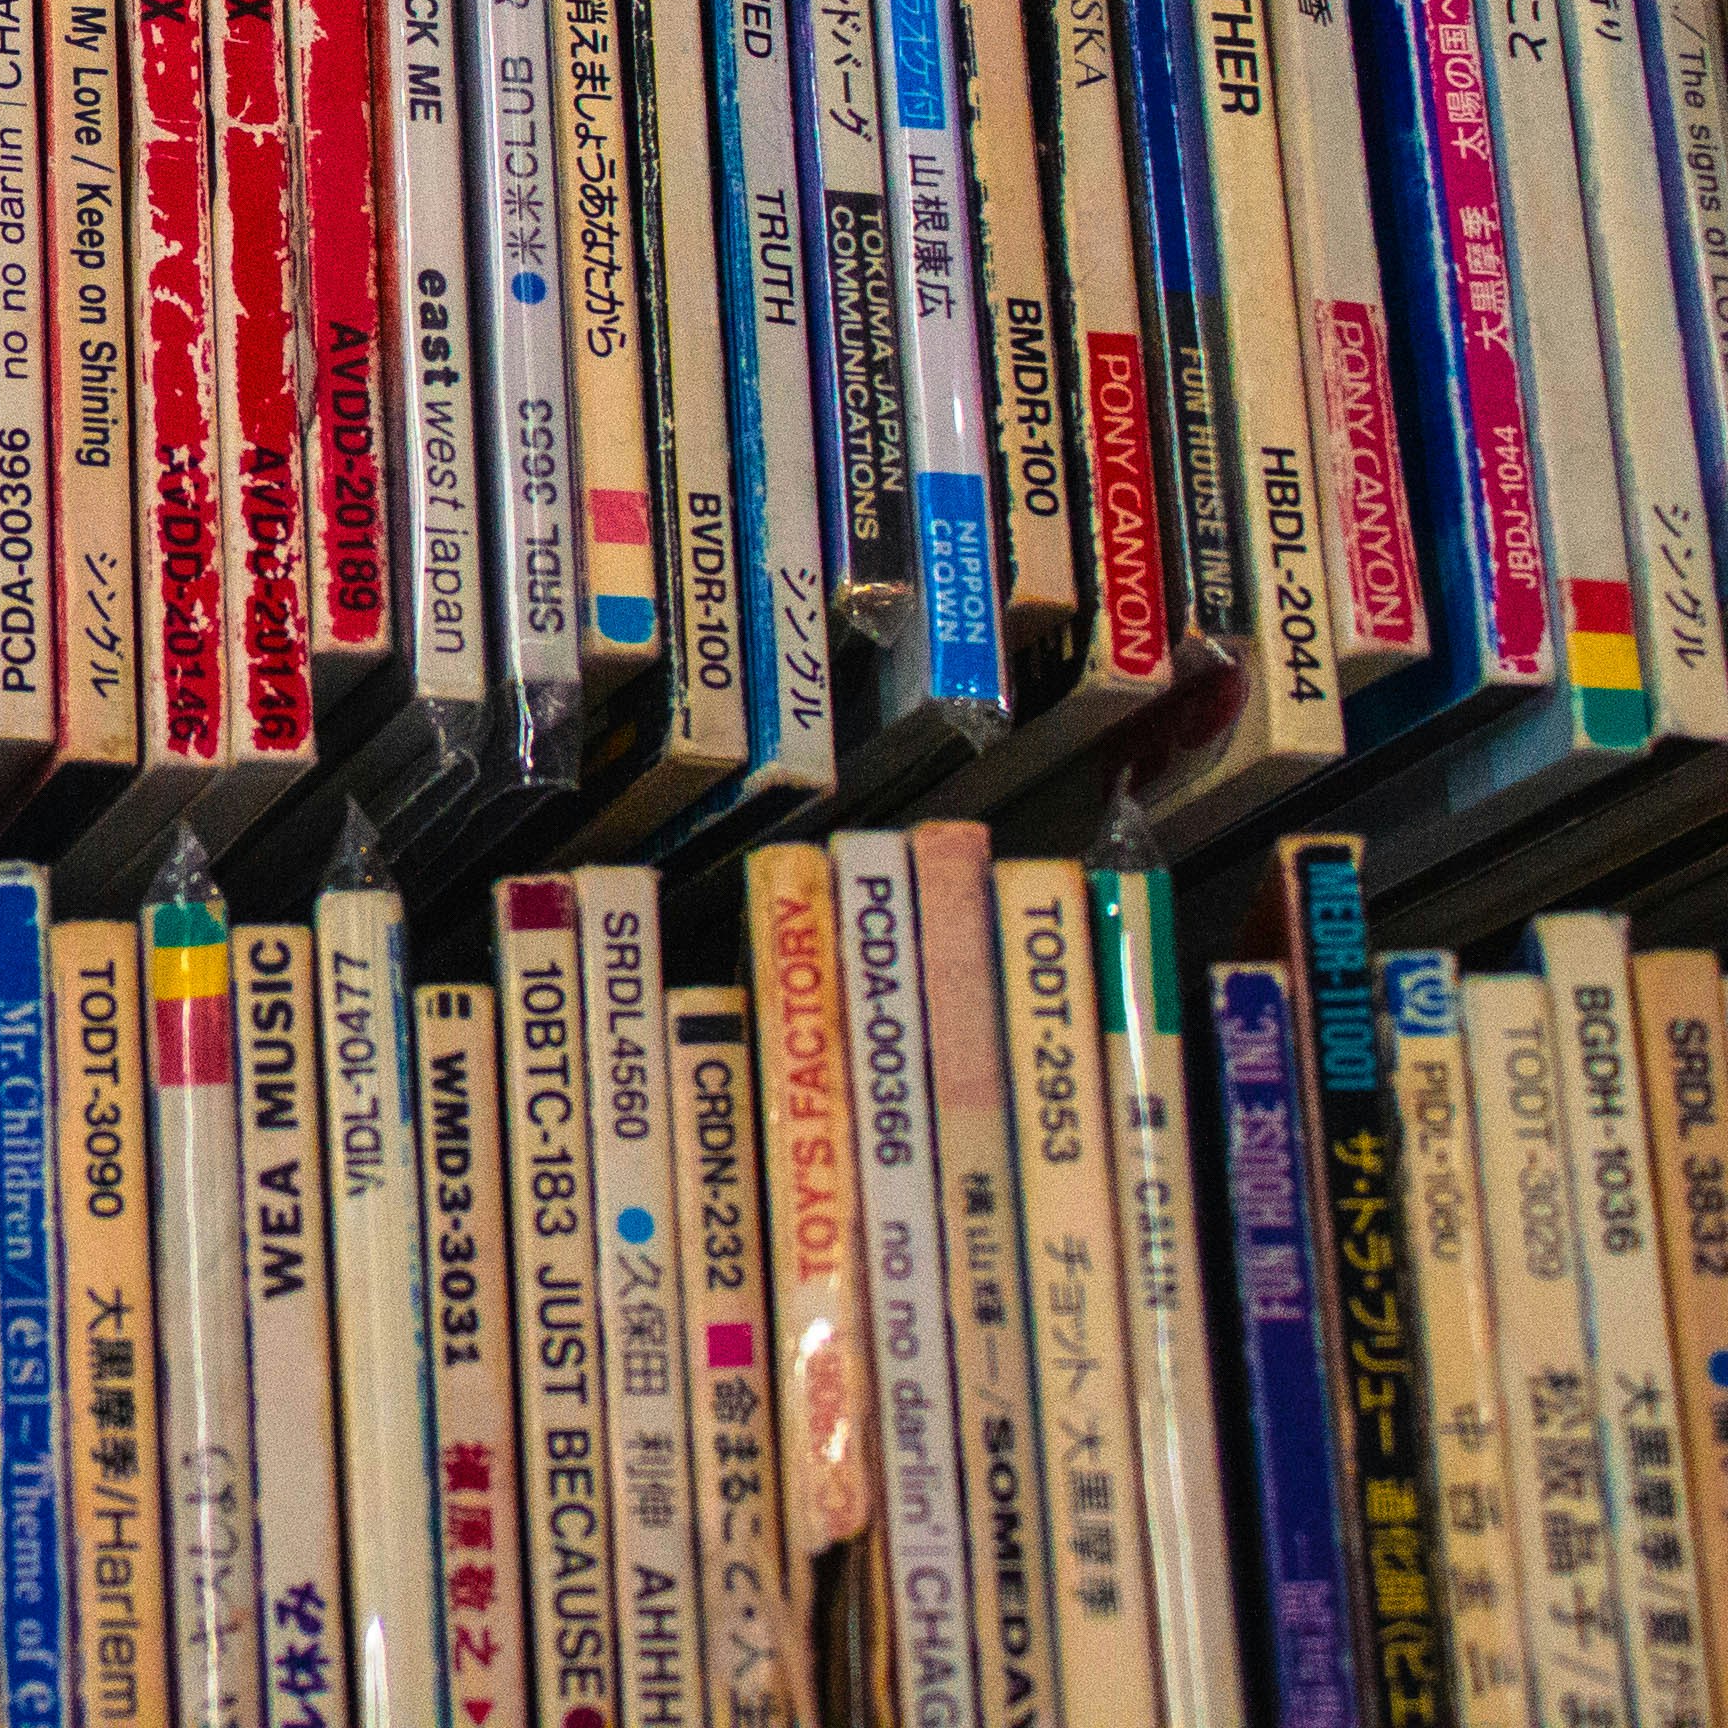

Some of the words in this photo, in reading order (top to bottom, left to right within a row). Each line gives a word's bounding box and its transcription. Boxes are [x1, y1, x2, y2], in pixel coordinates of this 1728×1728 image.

[754, 189, 795, 326] TRUTH
[1007, 297, 1060, 518] BMDR-100
[80, 551, 120, 695] シングル
[686, 490, 734, 690] BVDR-100
[1262, 446, 1326, 704] HBDL-2044
[78, 960, 122, 1219] TODT-3090
[249, 940, 302, 1134] MUSIC
[854, 875, 910, 1168] PCDA-00366
[1024, 899, 1080, 1164] TODT-2953
[259, 1160, 305, 1301] WEA
[429, 1052, 479, 1366] WMD3-3031
[694, 1062, 745, 1293] CRDN-232
[537, 1269, 588, 1405] JUST
[544, 1429, 606, 1700] BECAUSE
